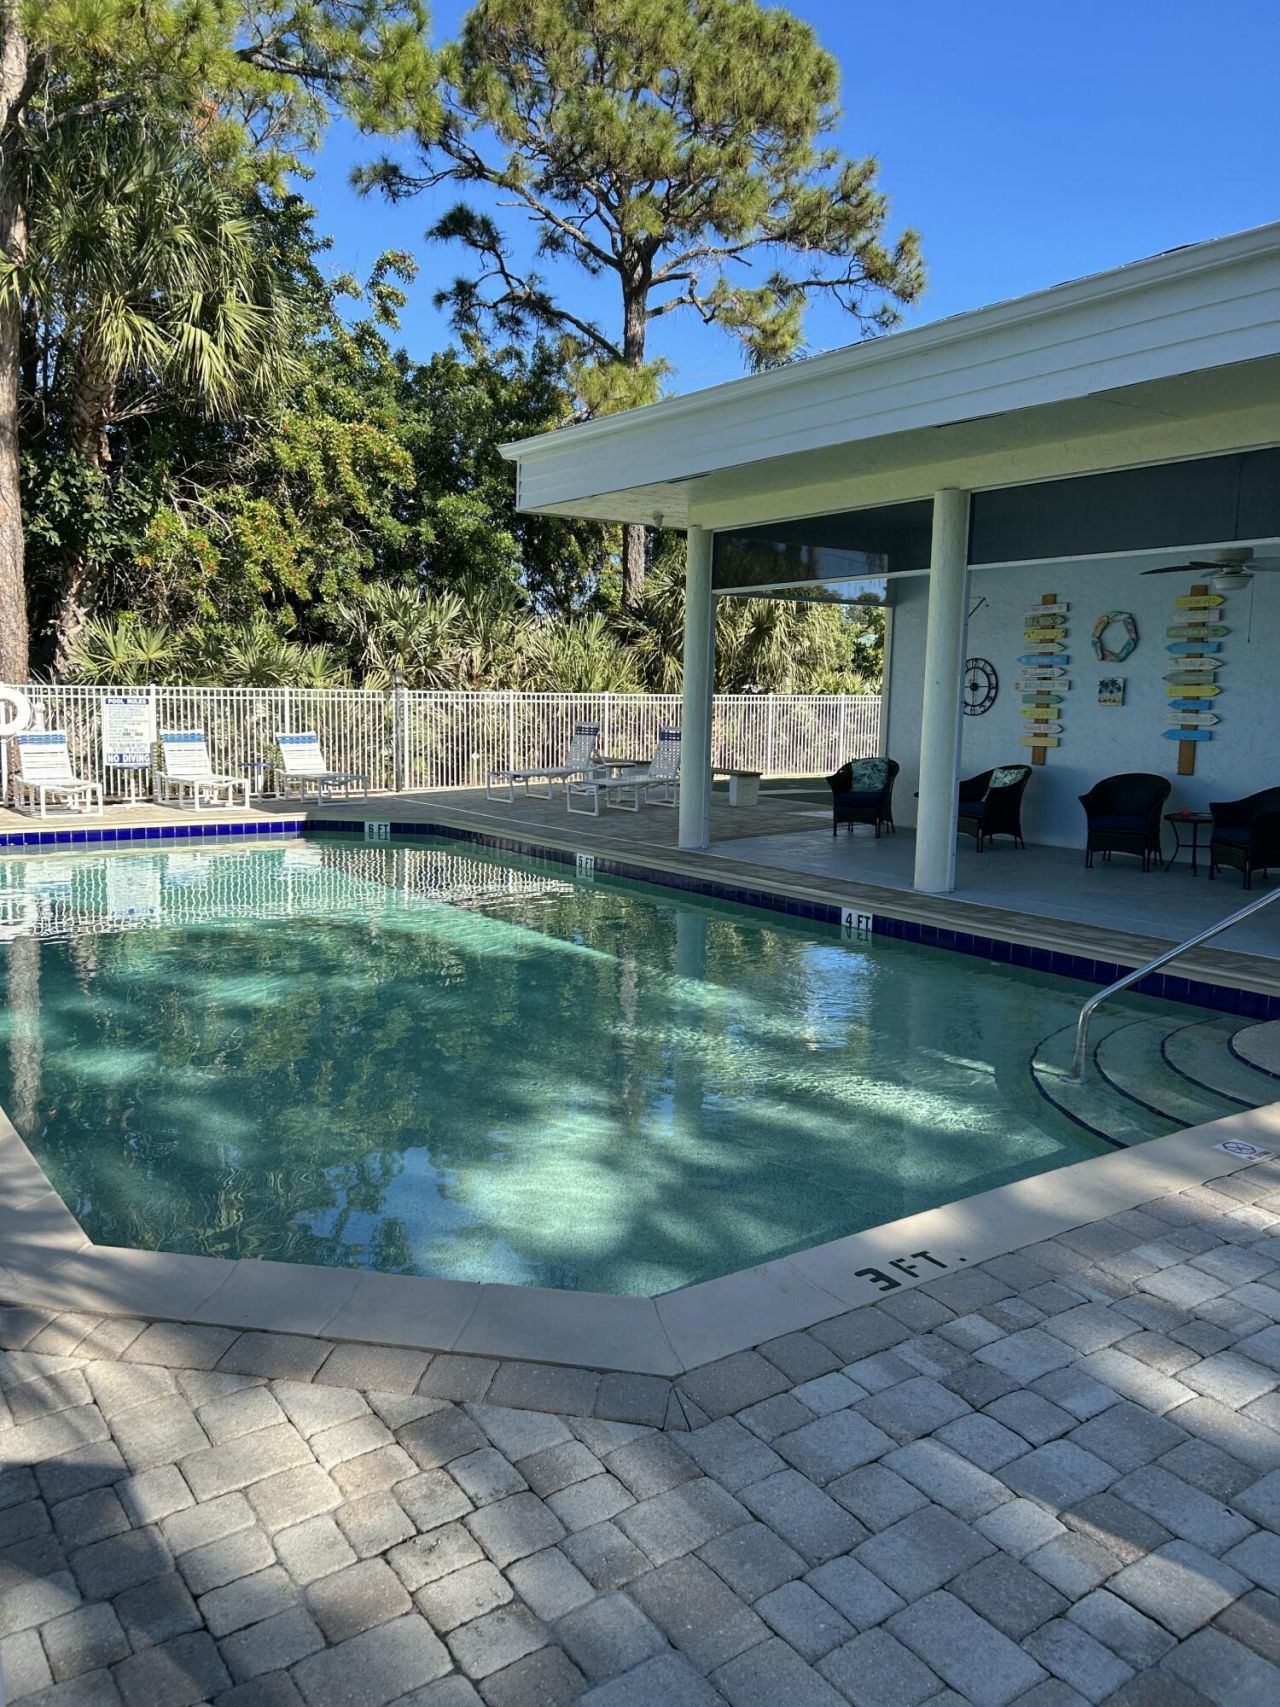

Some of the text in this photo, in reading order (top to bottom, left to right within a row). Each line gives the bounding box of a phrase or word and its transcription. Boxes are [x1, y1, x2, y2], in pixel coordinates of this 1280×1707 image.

[107, 754, 151, 763] NO DIVING
[368, 824, 388, 833] 6 FT
[578, 856, 594, 868] 5 FT
[845, 912, 871, 932] 4 FT
[854, 1267, 902, 1291] 3
